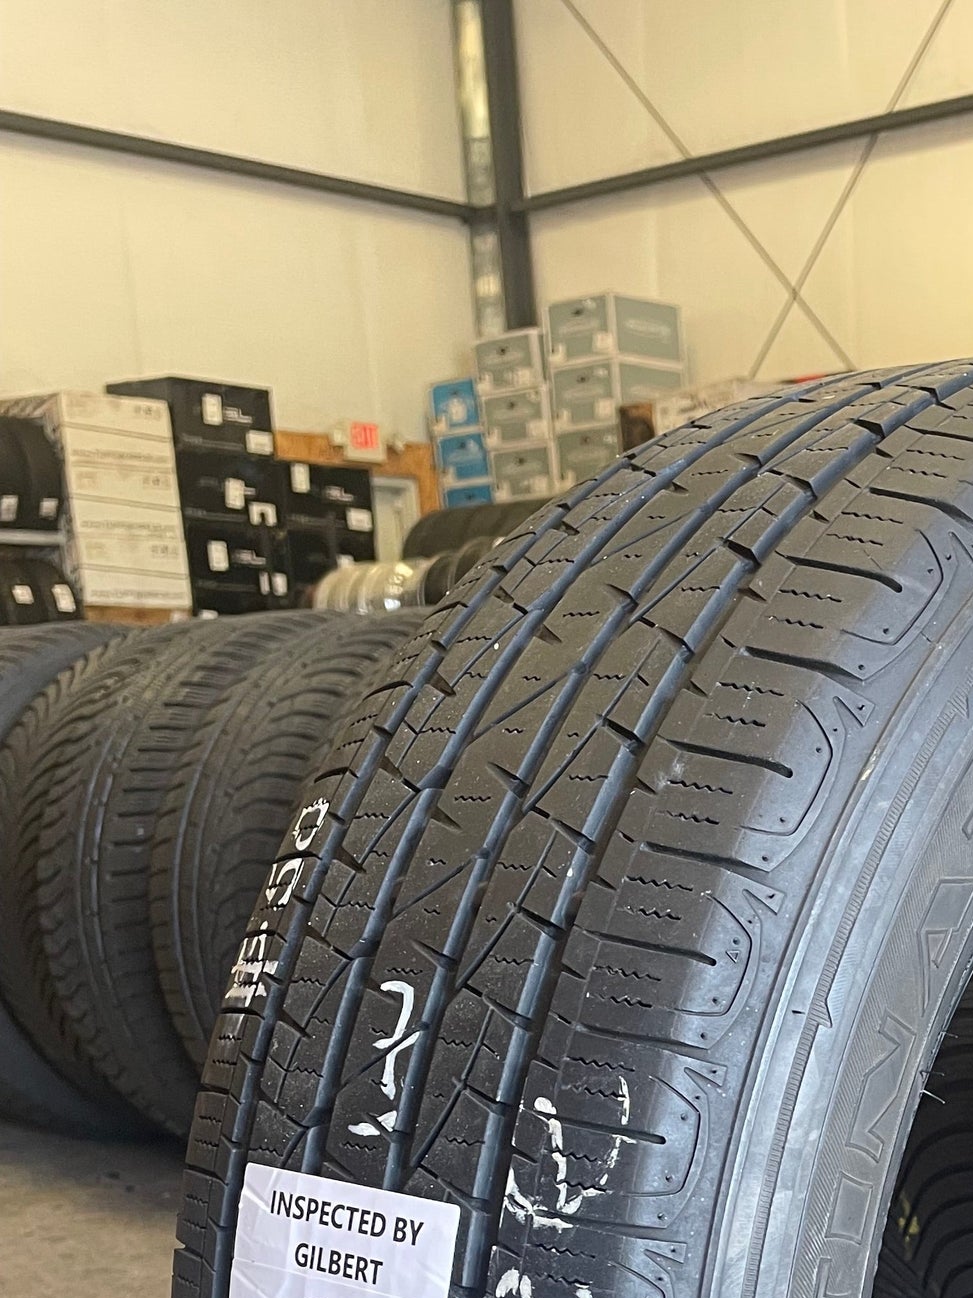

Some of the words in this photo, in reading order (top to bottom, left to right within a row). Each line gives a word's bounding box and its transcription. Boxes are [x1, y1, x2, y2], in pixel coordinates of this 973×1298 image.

[270, 1190, 387, 1239] INSPECTED
[393, 1217, 425, 1247] BY
[294, 1243, 384, 1285] GILBERT
